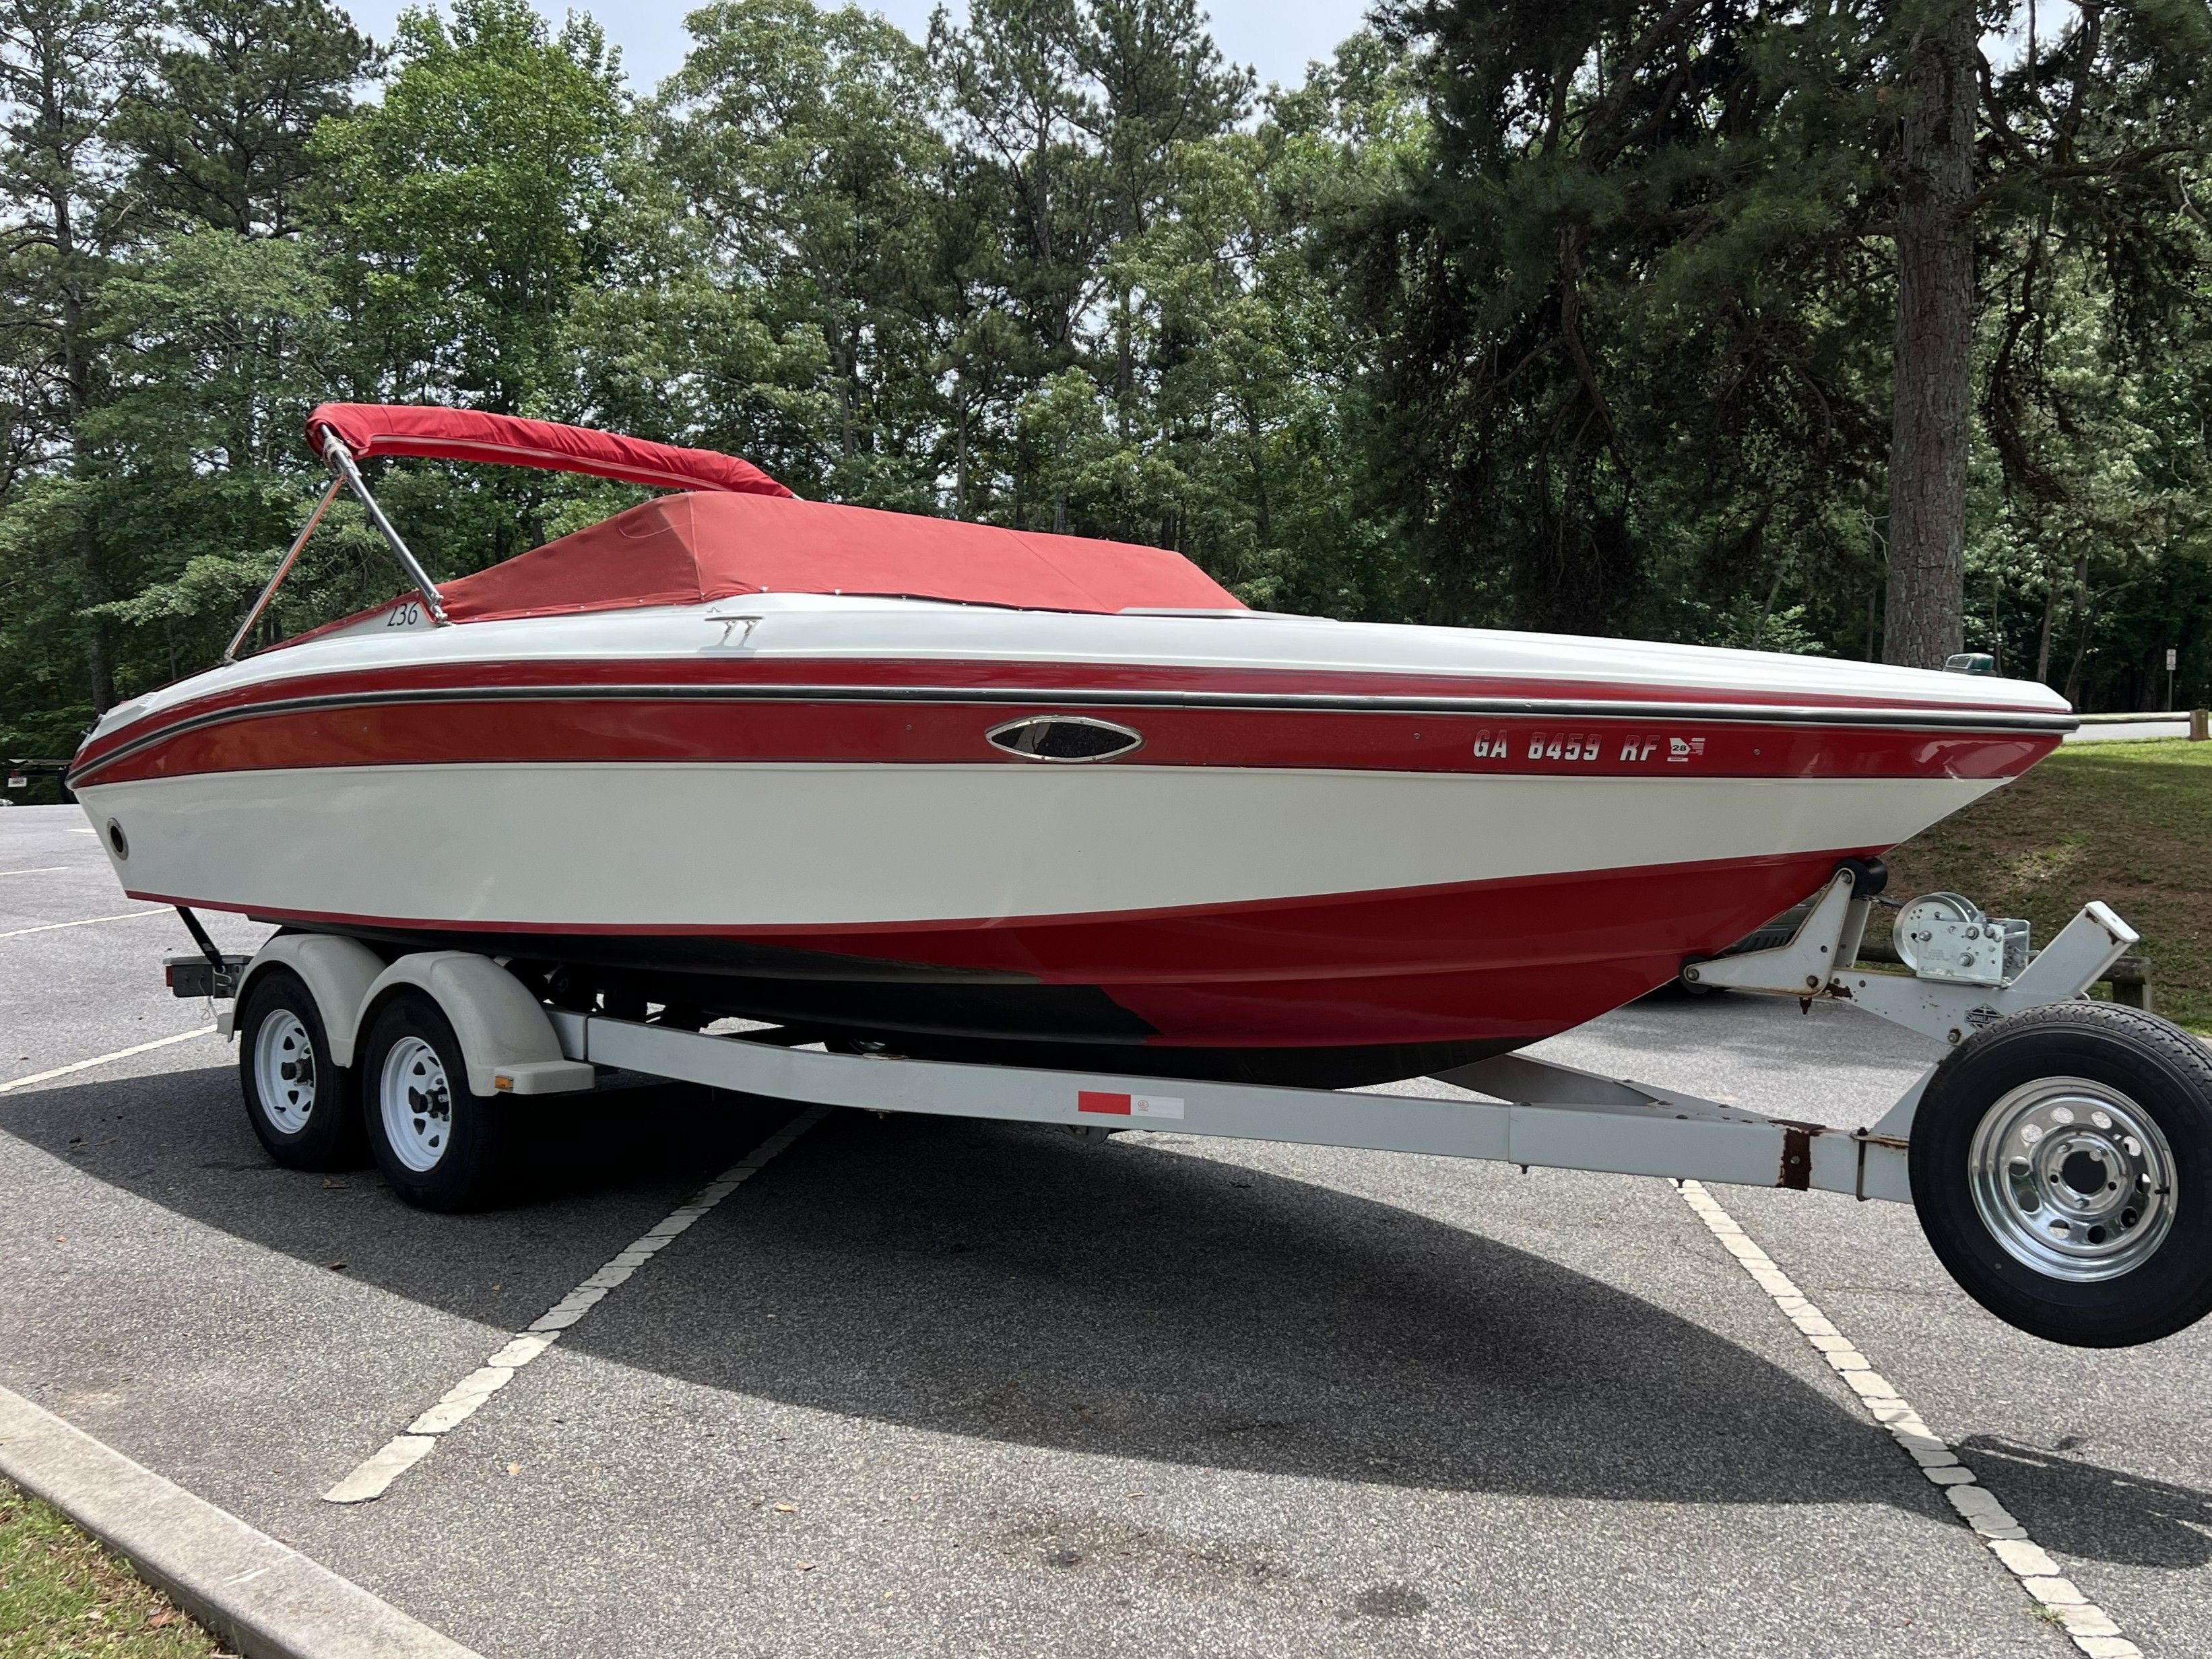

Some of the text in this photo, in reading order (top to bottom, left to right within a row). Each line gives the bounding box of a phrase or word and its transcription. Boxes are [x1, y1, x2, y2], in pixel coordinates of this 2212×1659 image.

[1473, 729, 1661, 761] GA 8459 RF
